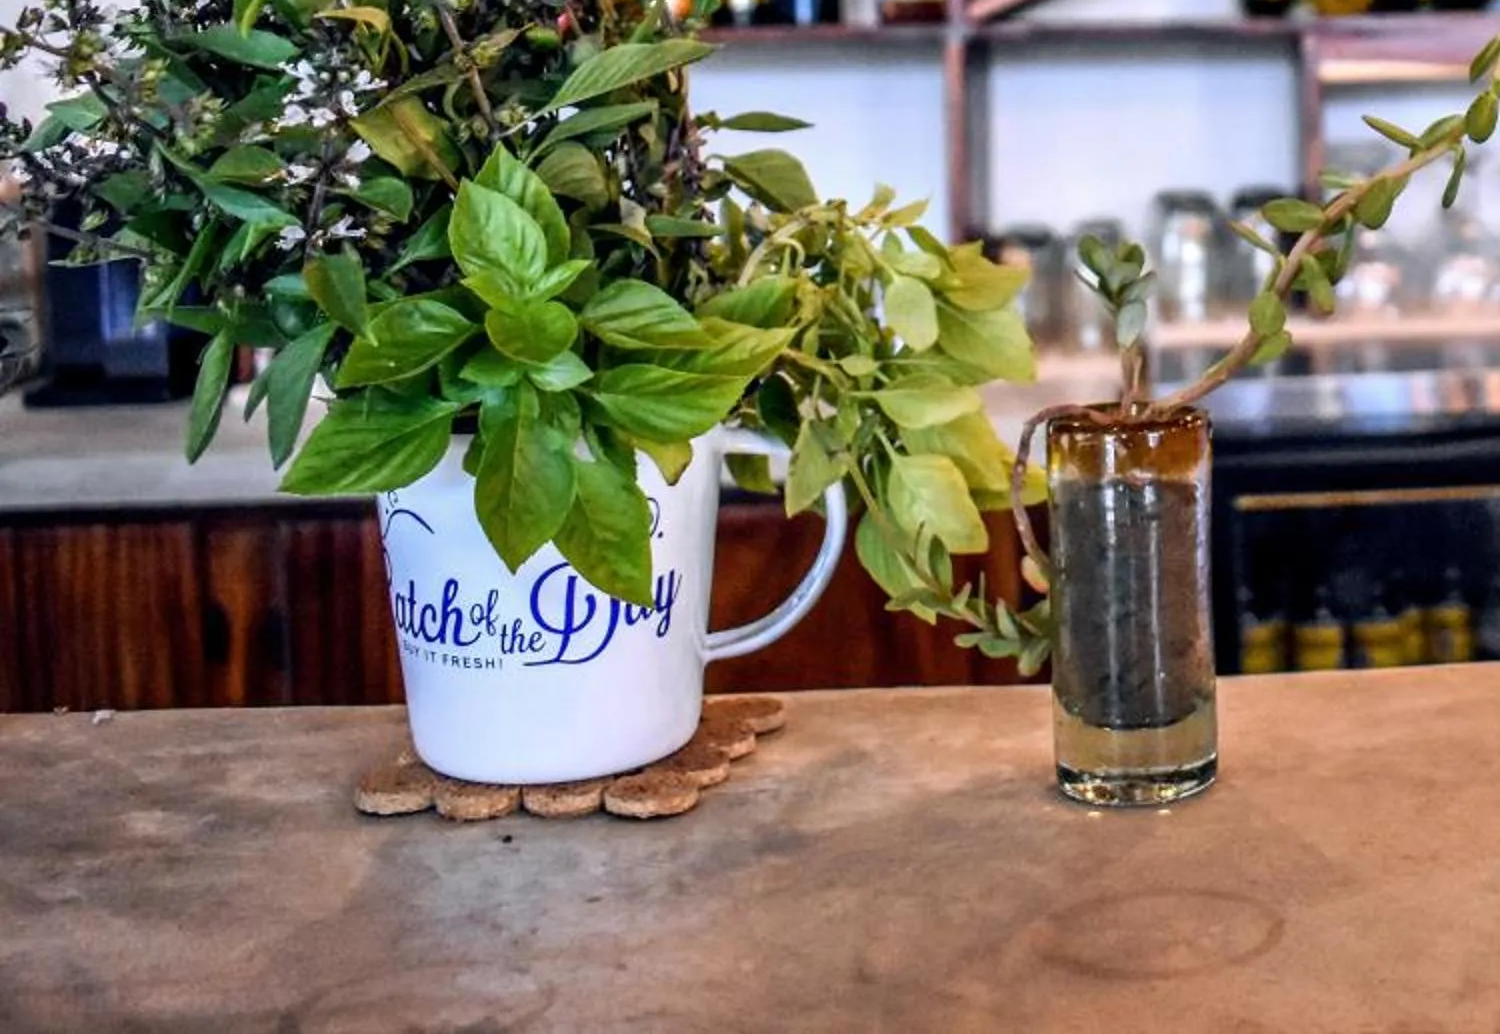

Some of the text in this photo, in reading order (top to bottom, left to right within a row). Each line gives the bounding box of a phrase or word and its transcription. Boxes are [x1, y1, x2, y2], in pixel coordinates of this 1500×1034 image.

[395, 578, 481, 647] atch
[469, 589, 499, 636] of
[501, 618, 546, 654] the
[442, 653, 503, 670] FRESH!
